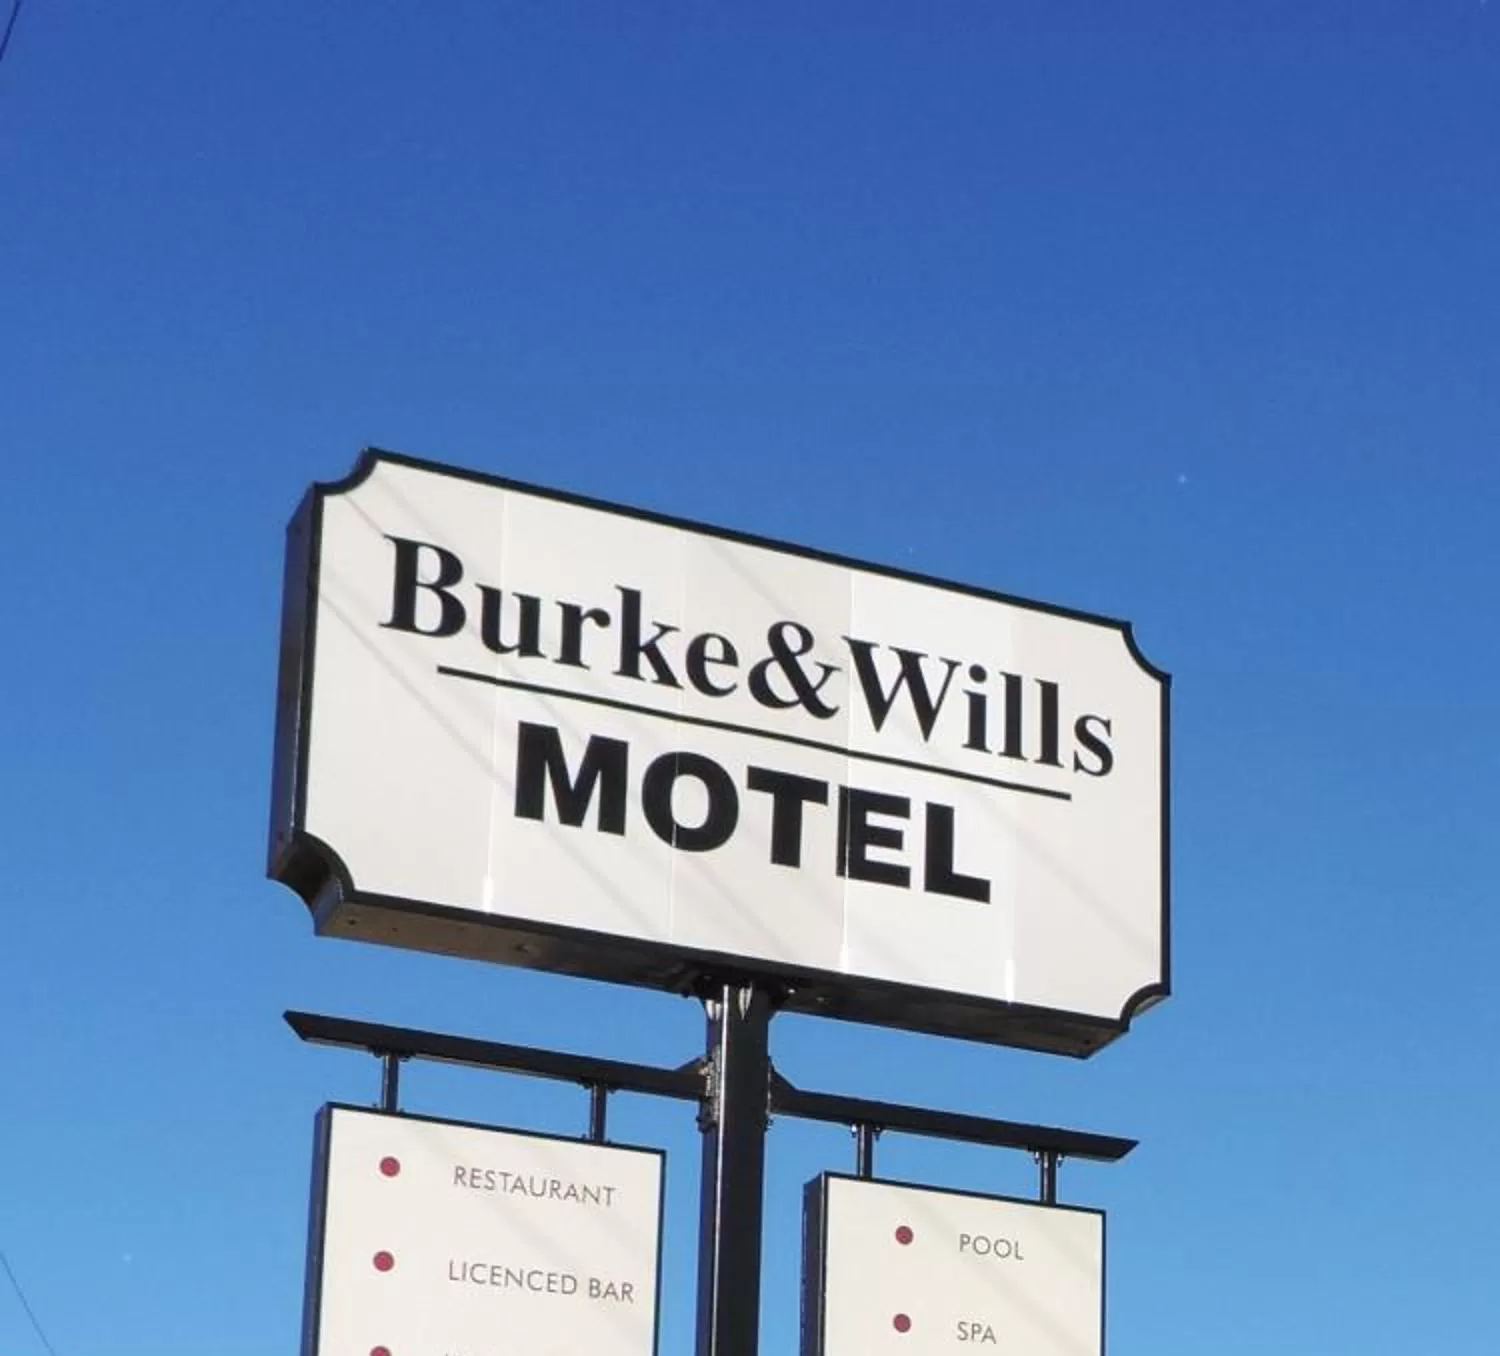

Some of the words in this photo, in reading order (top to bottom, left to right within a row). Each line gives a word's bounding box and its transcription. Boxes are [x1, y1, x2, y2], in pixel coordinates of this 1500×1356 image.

[381, 534, 1113, 777] Burke&Wills
[515, 721, 991, 903] MOTEL
[453, 1165, 616, 1207] RESTAURANT
[959, 1233, 1024, 1261] POOL
[448, 1259, 578, 1295] LICENCED
[587, 1276, 635, 1304] BAR
[956, 1321, 997, 1345] SPA
